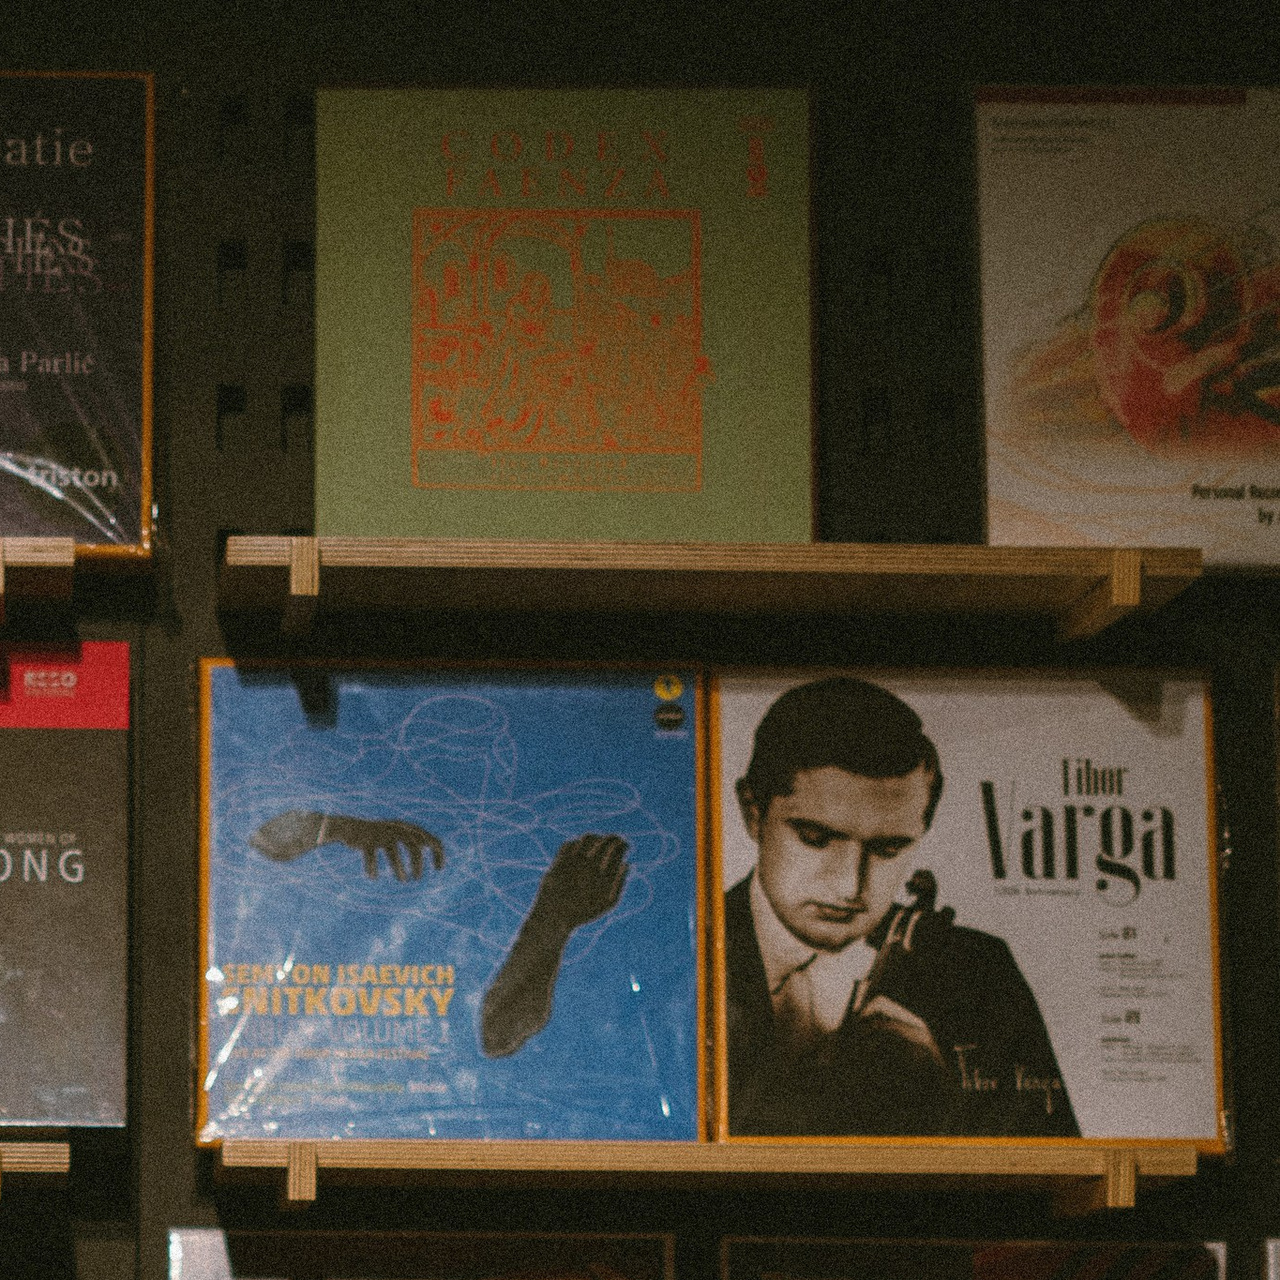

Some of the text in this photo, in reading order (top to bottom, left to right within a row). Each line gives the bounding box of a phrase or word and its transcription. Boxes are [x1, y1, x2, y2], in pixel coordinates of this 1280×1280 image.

[441, 132, 668, 162] CODEX
[447, 168, 670, 198] FAENZA
[978, 779, 1177, 908] Varga
[337, 964, 455, 986] ISAEVICH
